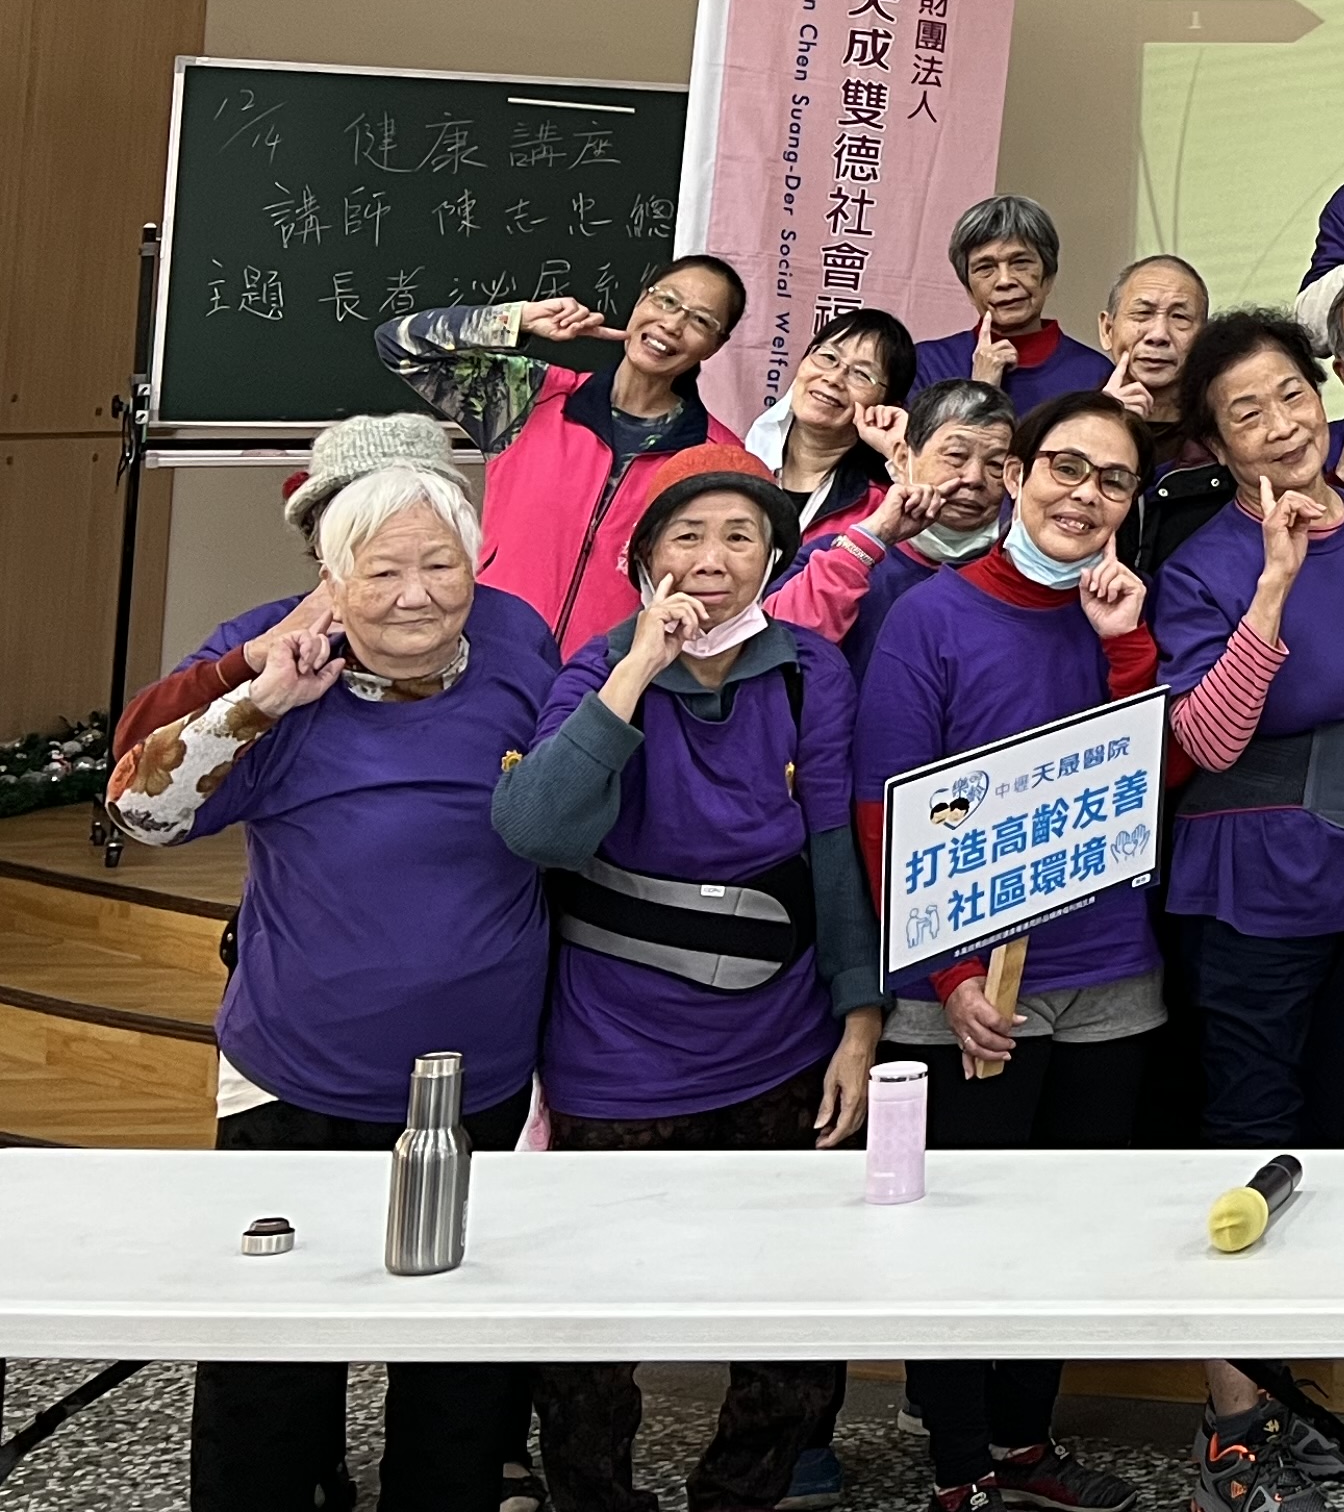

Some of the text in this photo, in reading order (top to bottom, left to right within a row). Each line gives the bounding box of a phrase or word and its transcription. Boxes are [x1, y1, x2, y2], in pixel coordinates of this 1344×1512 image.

[794, 23, 817, 81] Chen
[1189, 11, 1202, 29] 1
[344, 110, 622, 174] 健康講座
[783, 94, 810, 216] Suang-Der
[263, 182, 393, 249] 講師
[204, 259, 660, 323] 主題 長者泌尿系
[776, 228, 795, 299] Social
[763, 311, 792, 408] Welfare
[994, 736, 1131, 799] 中壢天晟醫院
[904, 769, 1149, 895] 打造高齡友善
[946, 835, 1108, 932] 社區環境
